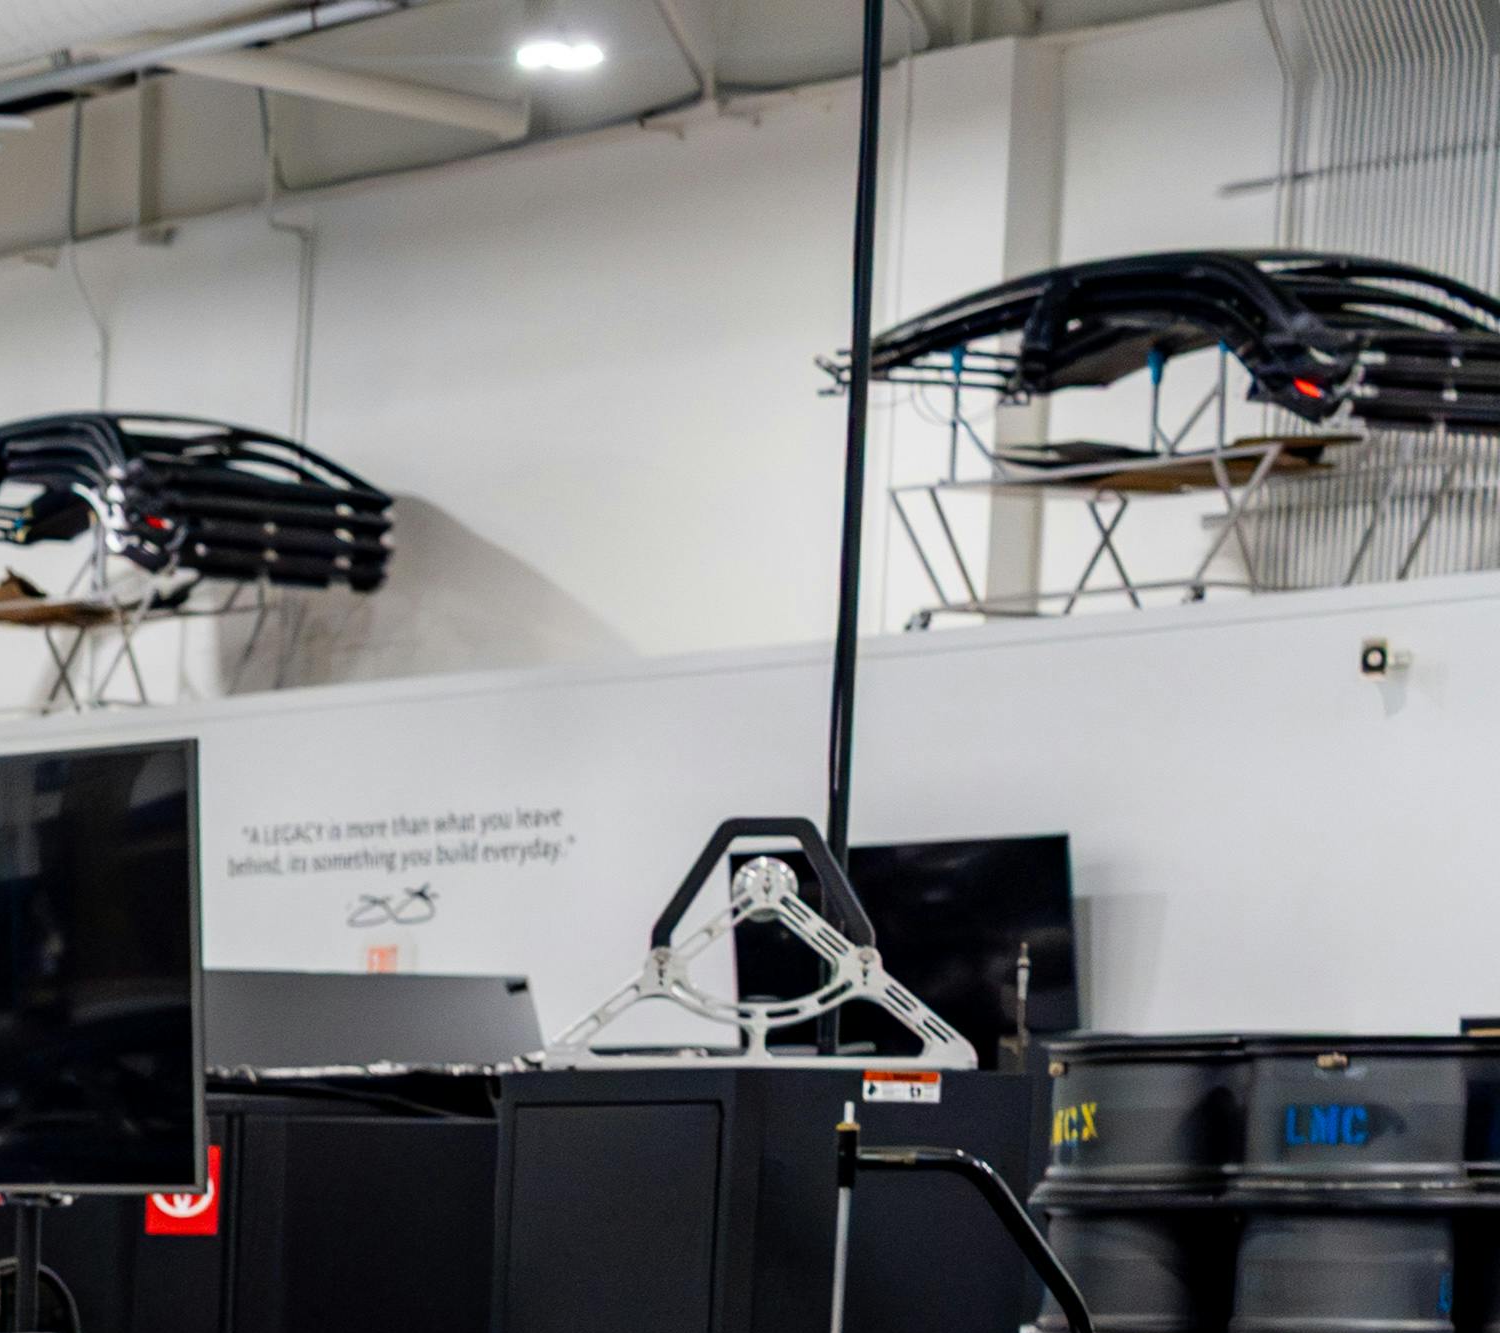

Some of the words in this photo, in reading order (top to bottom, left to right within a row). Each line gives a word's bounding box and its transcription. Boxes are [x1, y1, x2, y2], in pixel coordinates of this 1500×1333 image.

[347, 819, 388, 840] more
[392, 812, 430, 836] than
[434, 811, 476, 832] what
[480, 812, 513, 838] you
[516, 806, 563, 829] leave
[312, 846, 397, 875] something
[401, 847, 432, 873] you
[436, 840, 479, 866] build
[1286, 1104, 1369, 1146] LMC
